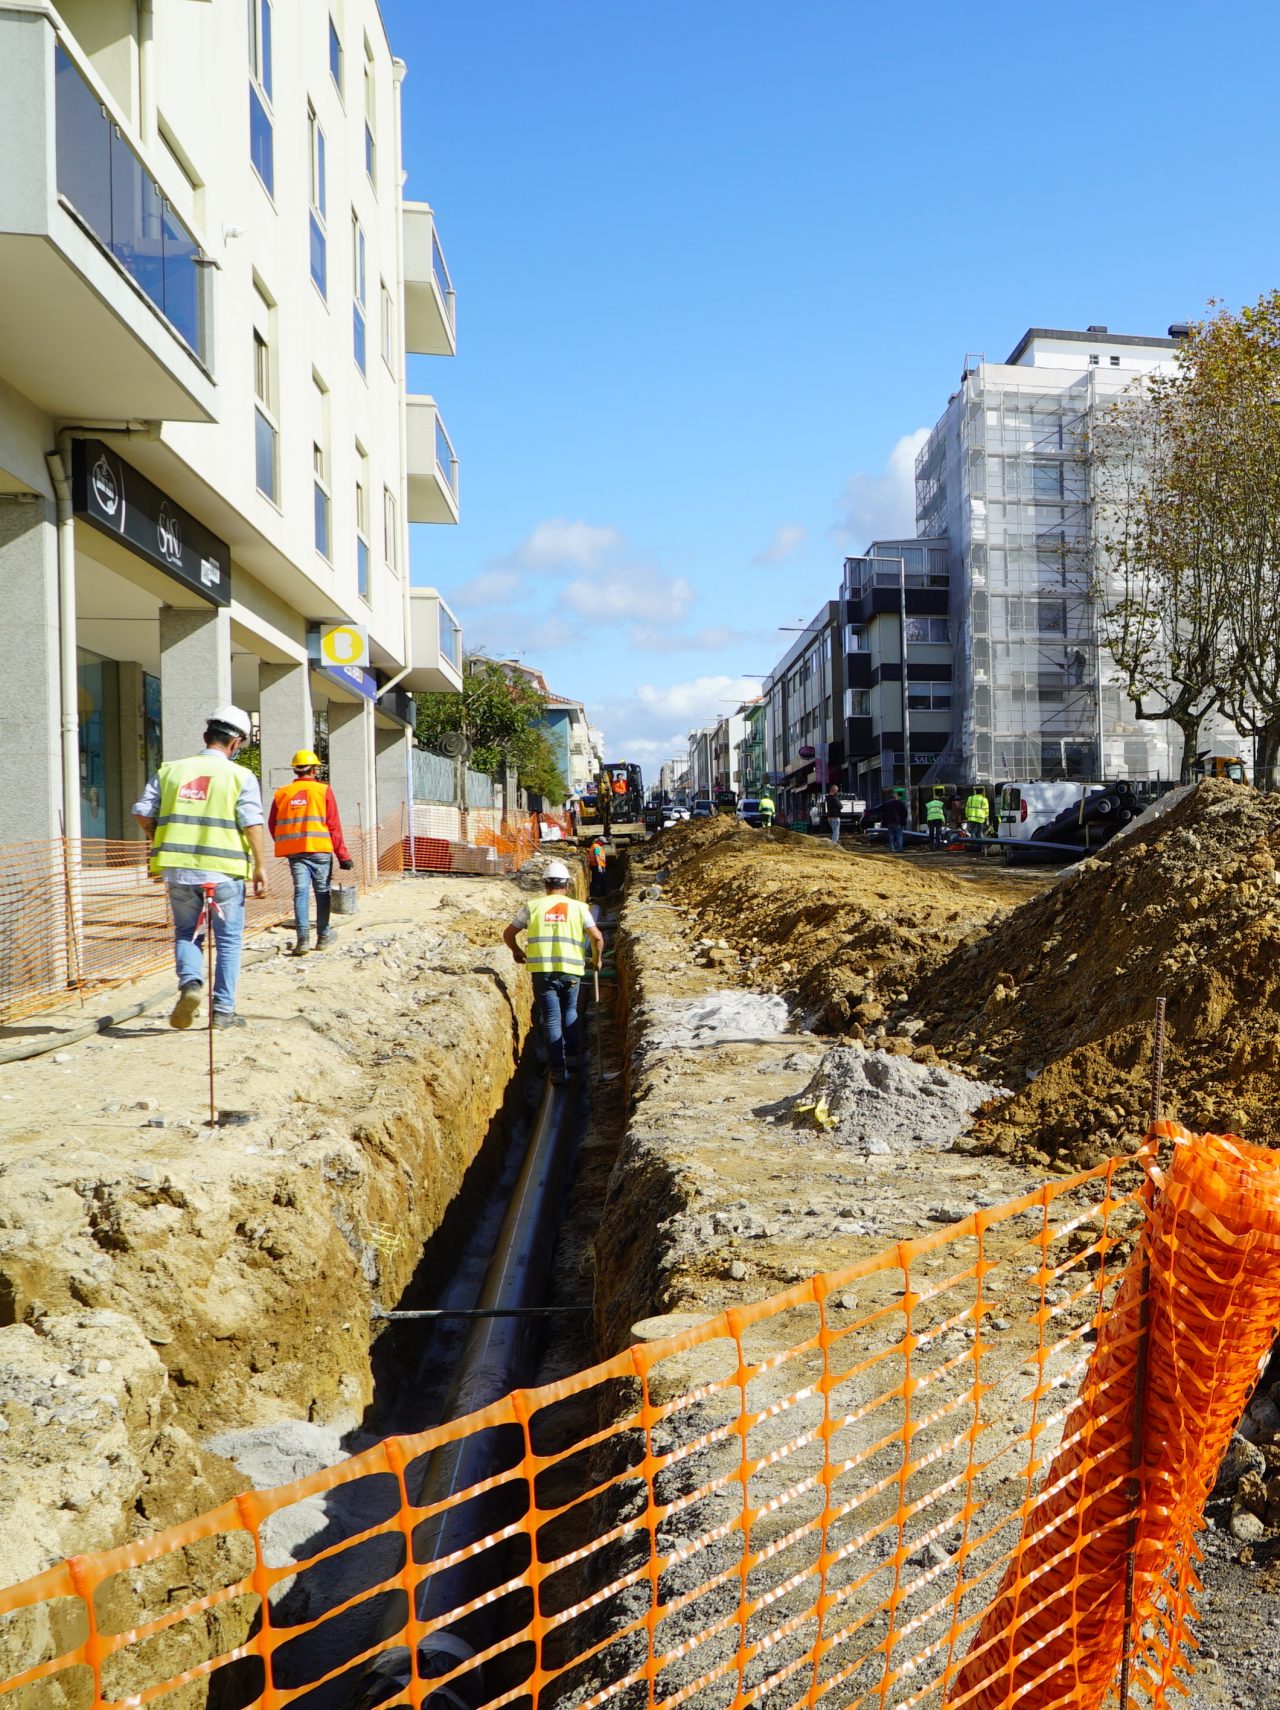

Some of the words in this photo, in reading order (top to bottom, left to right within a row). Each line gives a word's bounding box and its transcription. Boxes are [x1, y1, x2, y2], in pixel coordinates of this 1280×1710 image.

[334, 633, 353, 659] B
[180, 788, 206, 799] MCA
[545, 913, 566, 921] MCA
